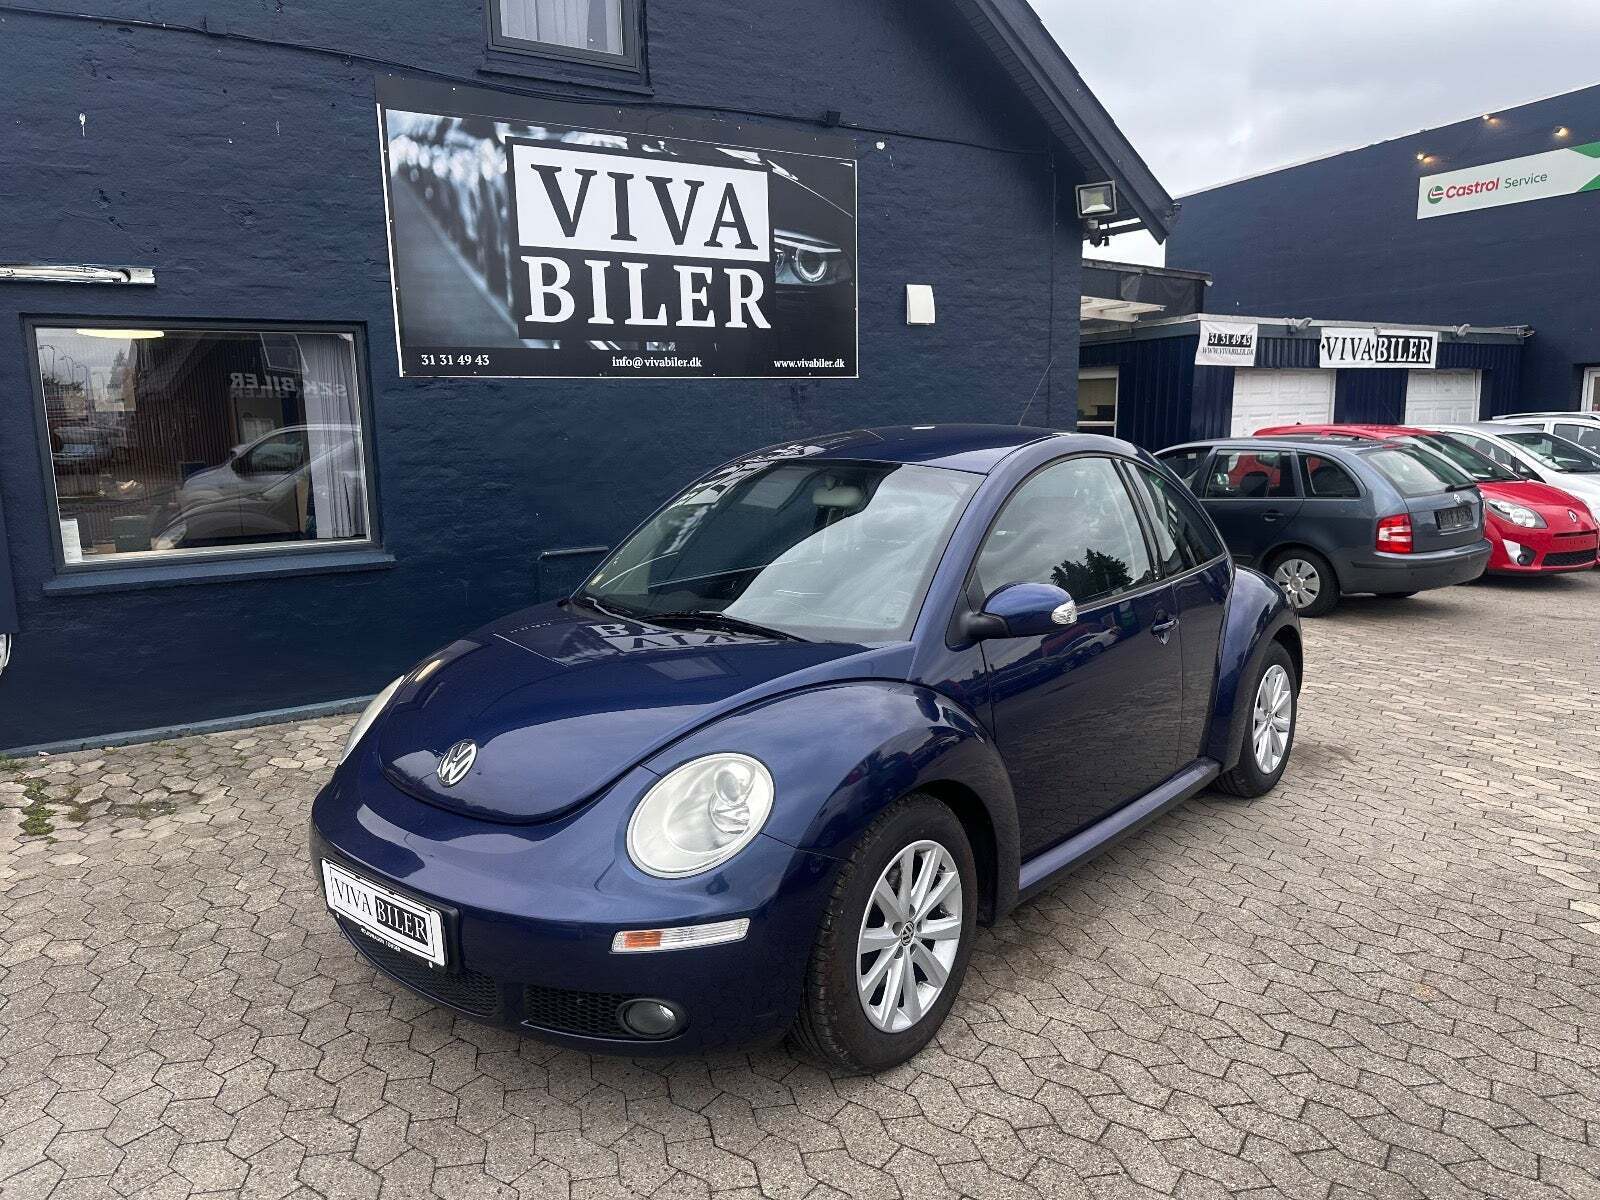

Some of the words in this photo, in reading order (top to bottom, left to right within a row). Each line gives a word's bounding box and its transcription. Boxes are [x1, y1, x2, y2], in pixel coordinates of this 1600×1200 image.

[1446, 178, 1500, 198] Castrol
[1504, 173, 1547, 189] Service
[530, 164, 758, 250] VIVA
[520, 255, 771, 329] BILER
[1209, 333, 1218, 344] 31
[1231, 333, 1241, 345] 49
[1325, 336, 1373, 361] VIVA
[1376, 337, 1430, 362] BILER
[421, 354, 436, 366] 31
[439, 354, 454, 366] 31
[457, 354, 472, 366] 49
[474, 354, 490, 366] 43
[774, 359, 845, 368] www.vivabiler.dk
[332, 877, 372, 916] VIVA
[376, 898, 428, 945] BILER
